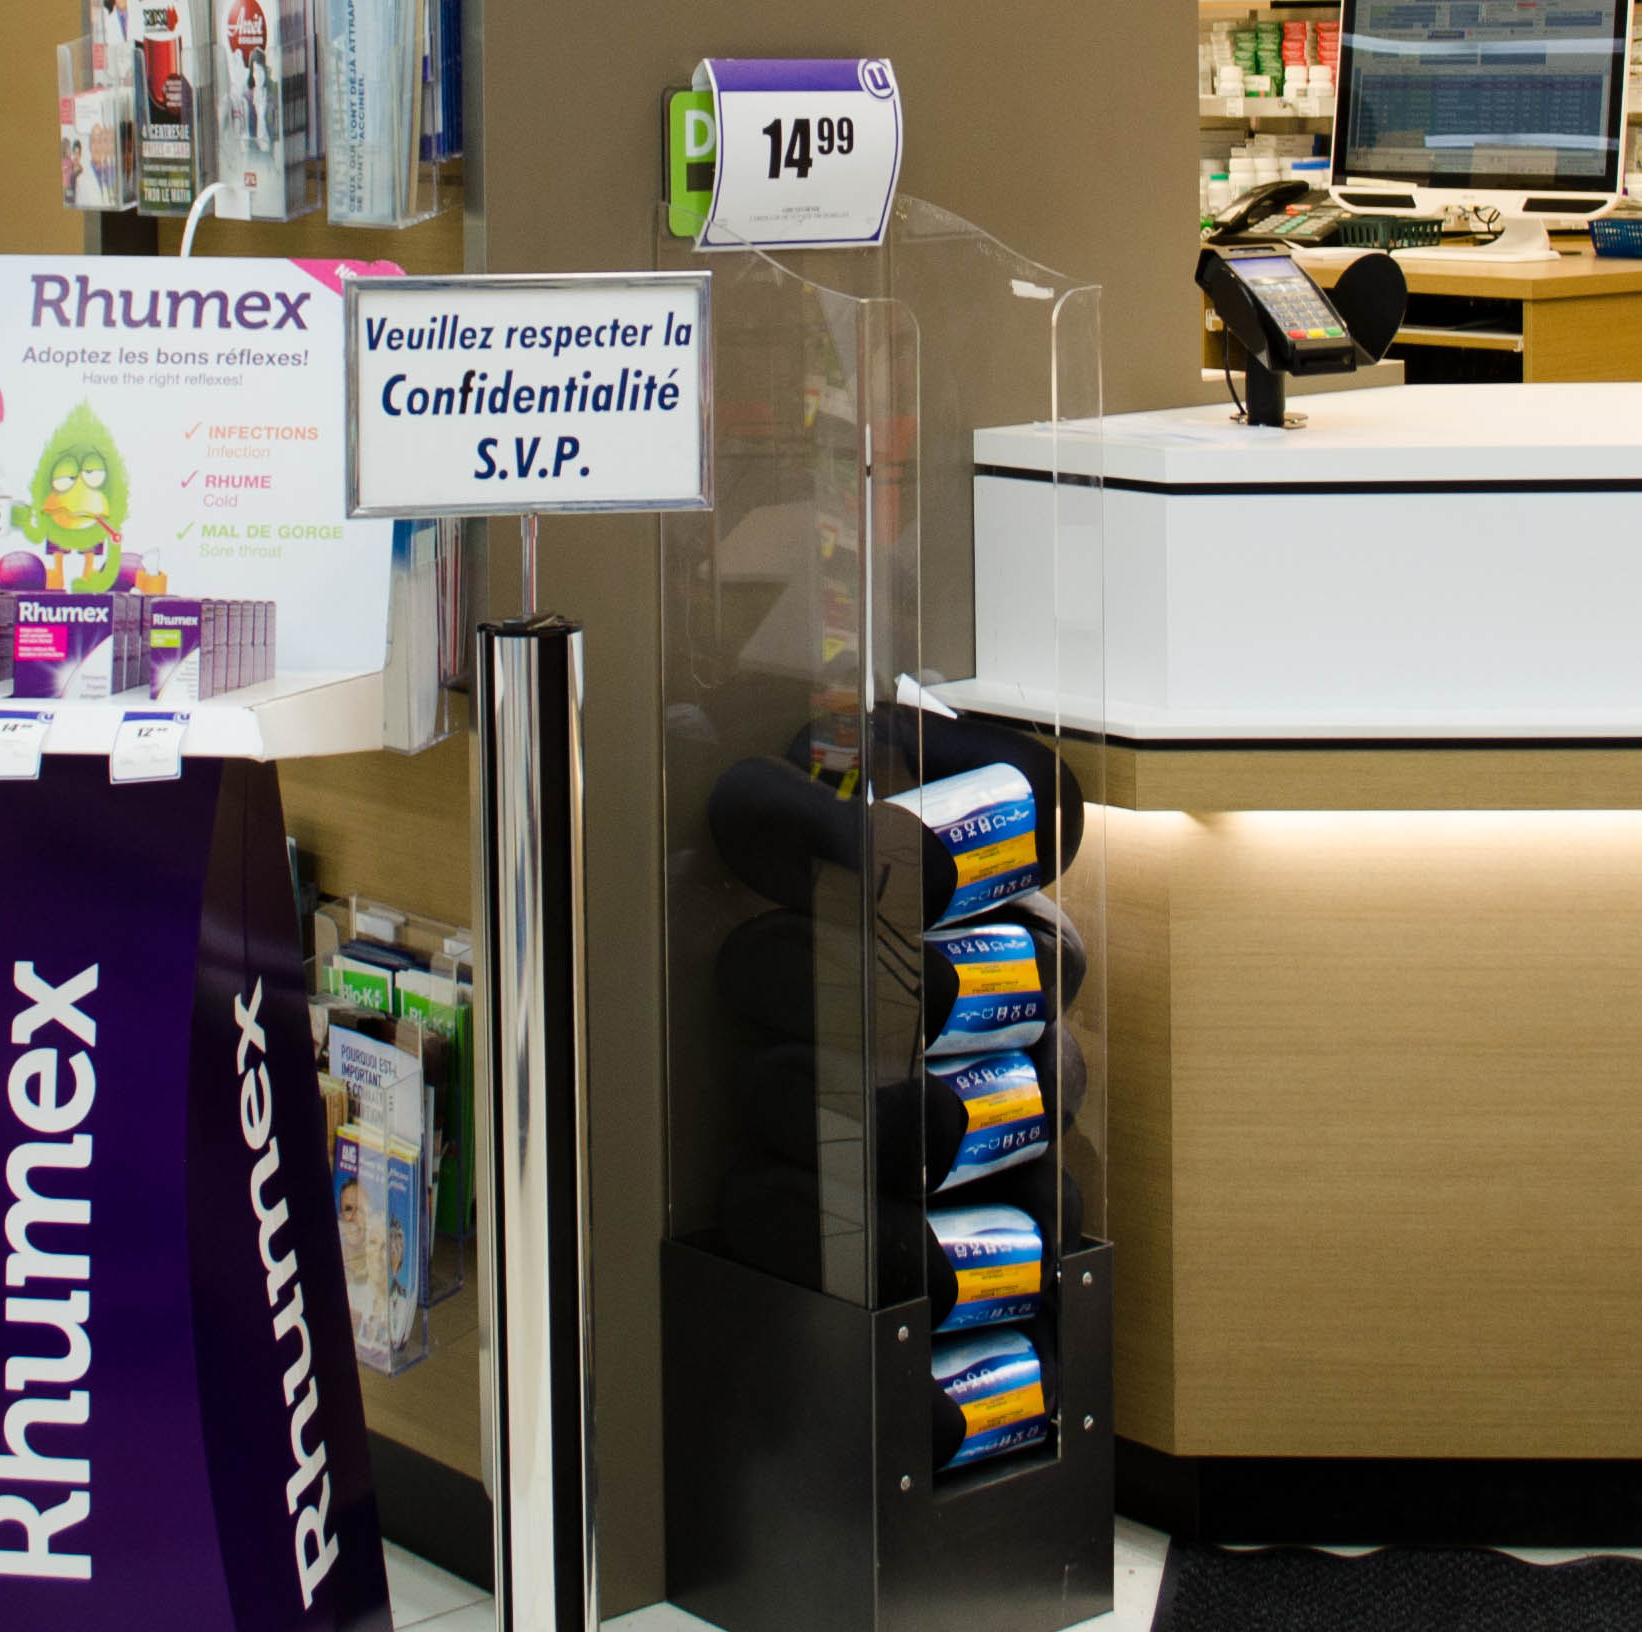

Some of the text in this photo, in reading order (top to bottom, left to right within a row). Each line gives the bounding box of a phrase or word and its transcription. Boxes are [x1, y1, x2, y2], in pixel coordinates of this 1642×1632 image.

[30, 273, 312, 331] Rhumex
[365, 311, 693, 357] Veuillez respecter la
[21, 345, 310, 368] Adoptez les bons réflexes!
[82, 372, 244, 389] Have the right reflexes!
[381, 367, 680, 417] Confidentialité
[208, 425, 319, 442] INFECTIONS
[207, 444, 270, 459] Infection
[473, 435, 591, 481] S.V.P.
[204, 474, 272, 490] RHUME
[203, 493, 238, 509] Cold
[201, 524, 345, 541] MAL DE GORGE
[200, 543, 282, 559] Sore throat
[18, 601, 110, 624] Rhumex
[152, 613, 199, 626] Rhumex
[340, 1061, 382, 1088] IMPORTANT
[233, 975, 340, 1611] Rhumex
